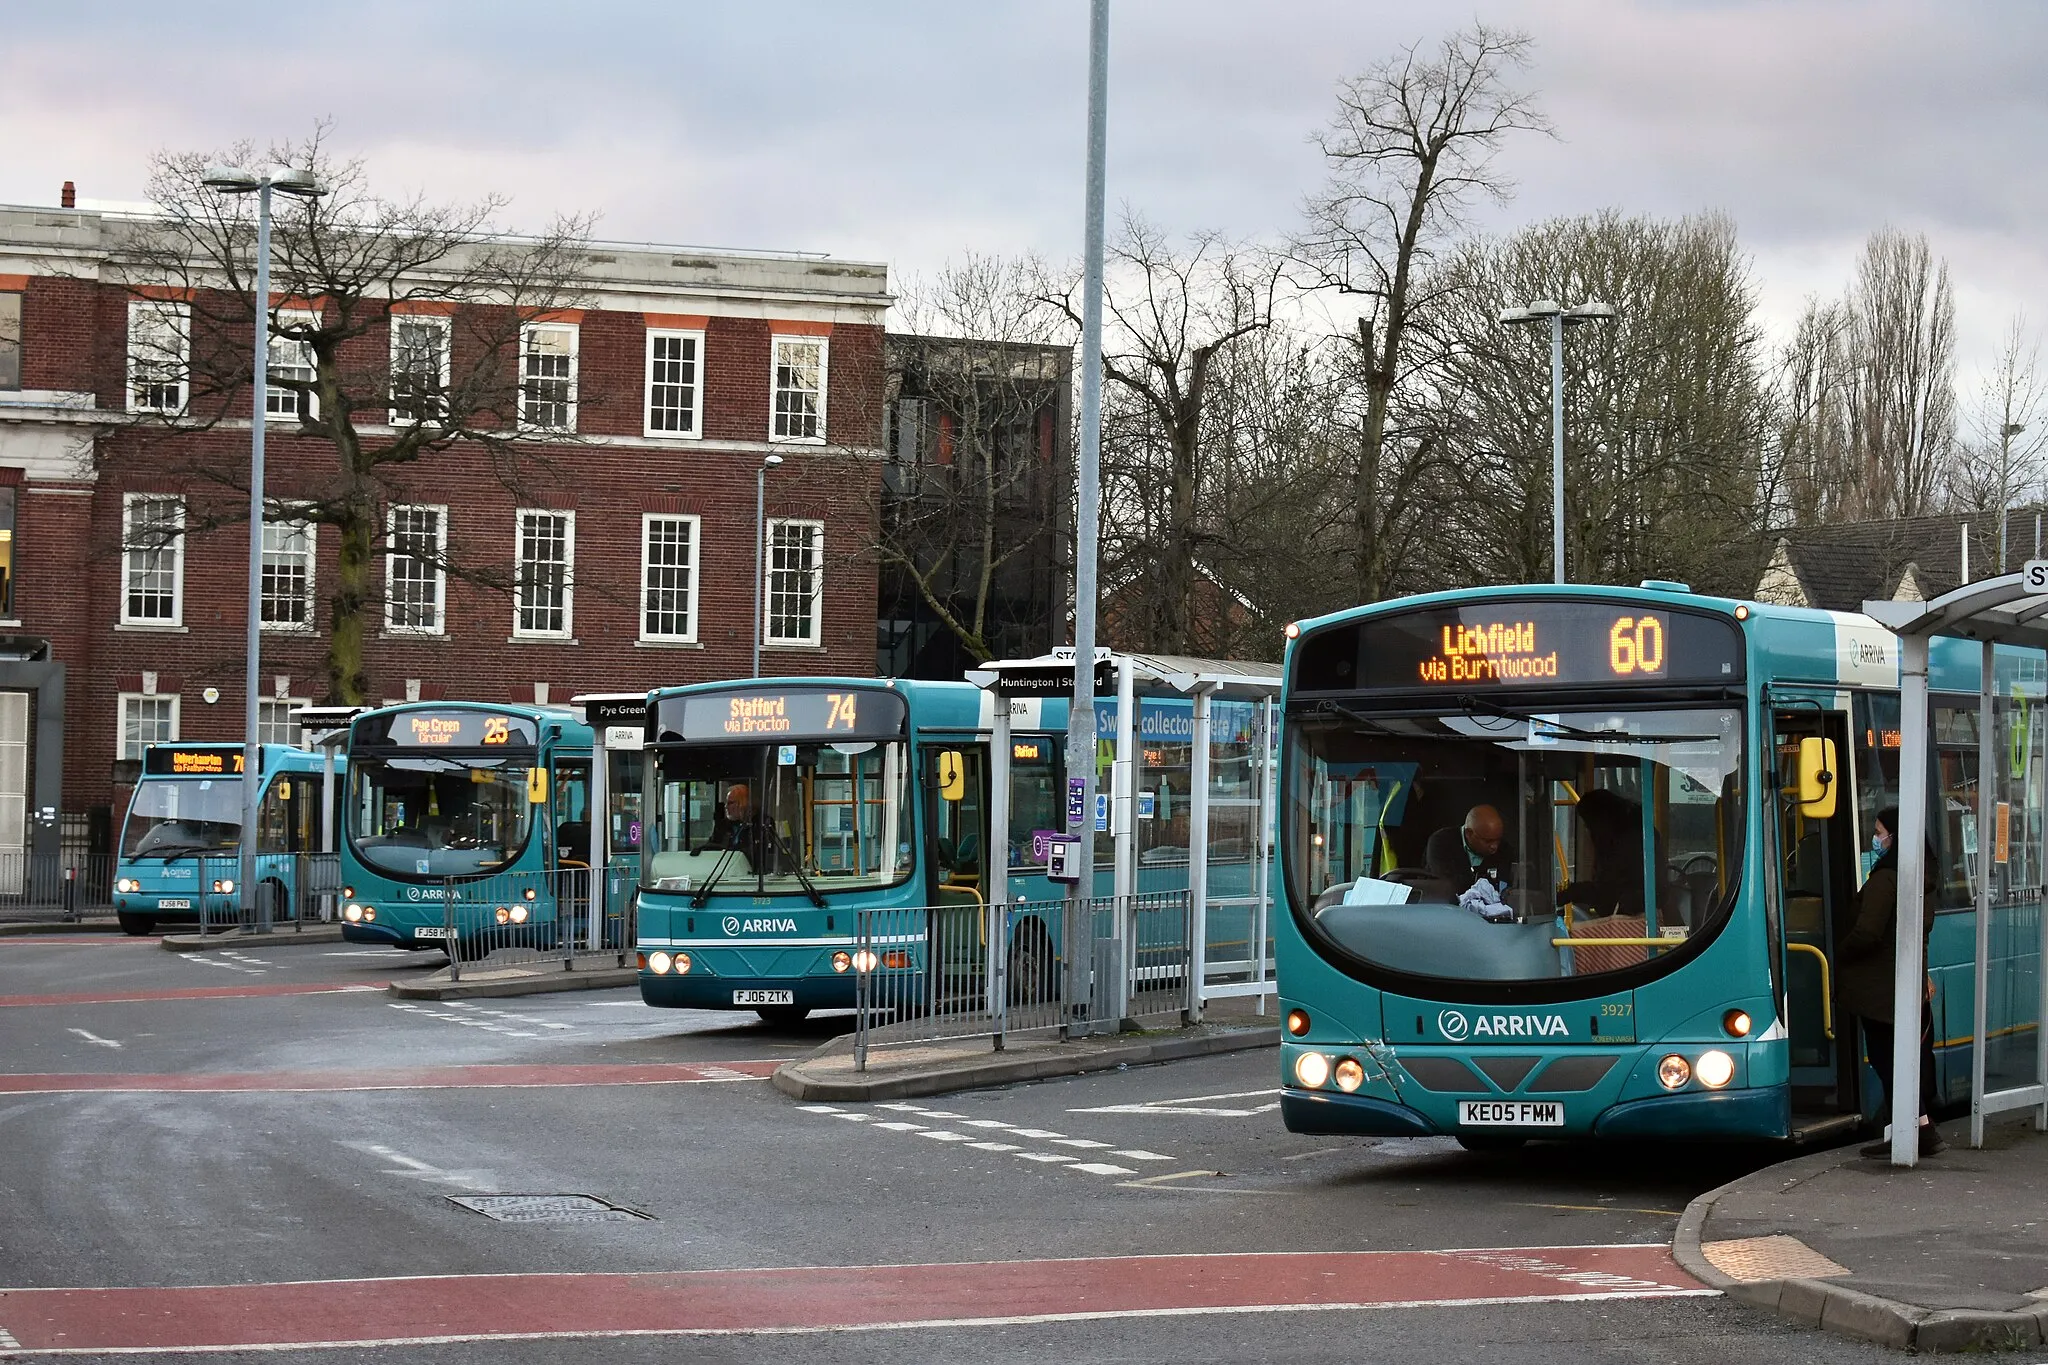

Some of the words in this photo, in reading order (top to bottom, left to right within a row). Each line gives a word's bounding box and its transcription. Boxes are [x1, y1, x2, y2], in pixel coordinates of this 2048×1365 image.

[1443, 621, 1535, 656] Lichfield
[1610, 616, 1663, 674] 60
[1859, 643, 1886, 664] ARRIVA
[1419, 655, 1448, 681] via
[1452, 651, 1557, 681] Burntwood
[1000, 677, 1055, 689] Huntington
[601, 705, 617, 717] Pye
[618, 705, 646, 714] Green
[730, 697, 785, 717] Stafford
[826, 694, 857, 730] 74
[411, 718, 430, 733] Pye
[432, 719, 460, 733] Green
[484, 718, 509, 744] 25
[724, 719, 742, 733] via
[744, 716, 790, 732] Brocton
[418, 734, 452, 744] Circular
[752, 897, 771, 905] 3723
[418, 928, 438, 937] FJ58
[742, 918, 798, 932] ARRIVA
[736, 991, 766, 1003] FJ06
[767, 991, 789, 1003] ZTK
[1601, 1004, 1632, 1017] 3927
[1473, 1015, 1570, 1037] ARRIVA
[1467, 1103, 1516, 1122] KE05
[1520, 1104, 1557, 1122] FMM
